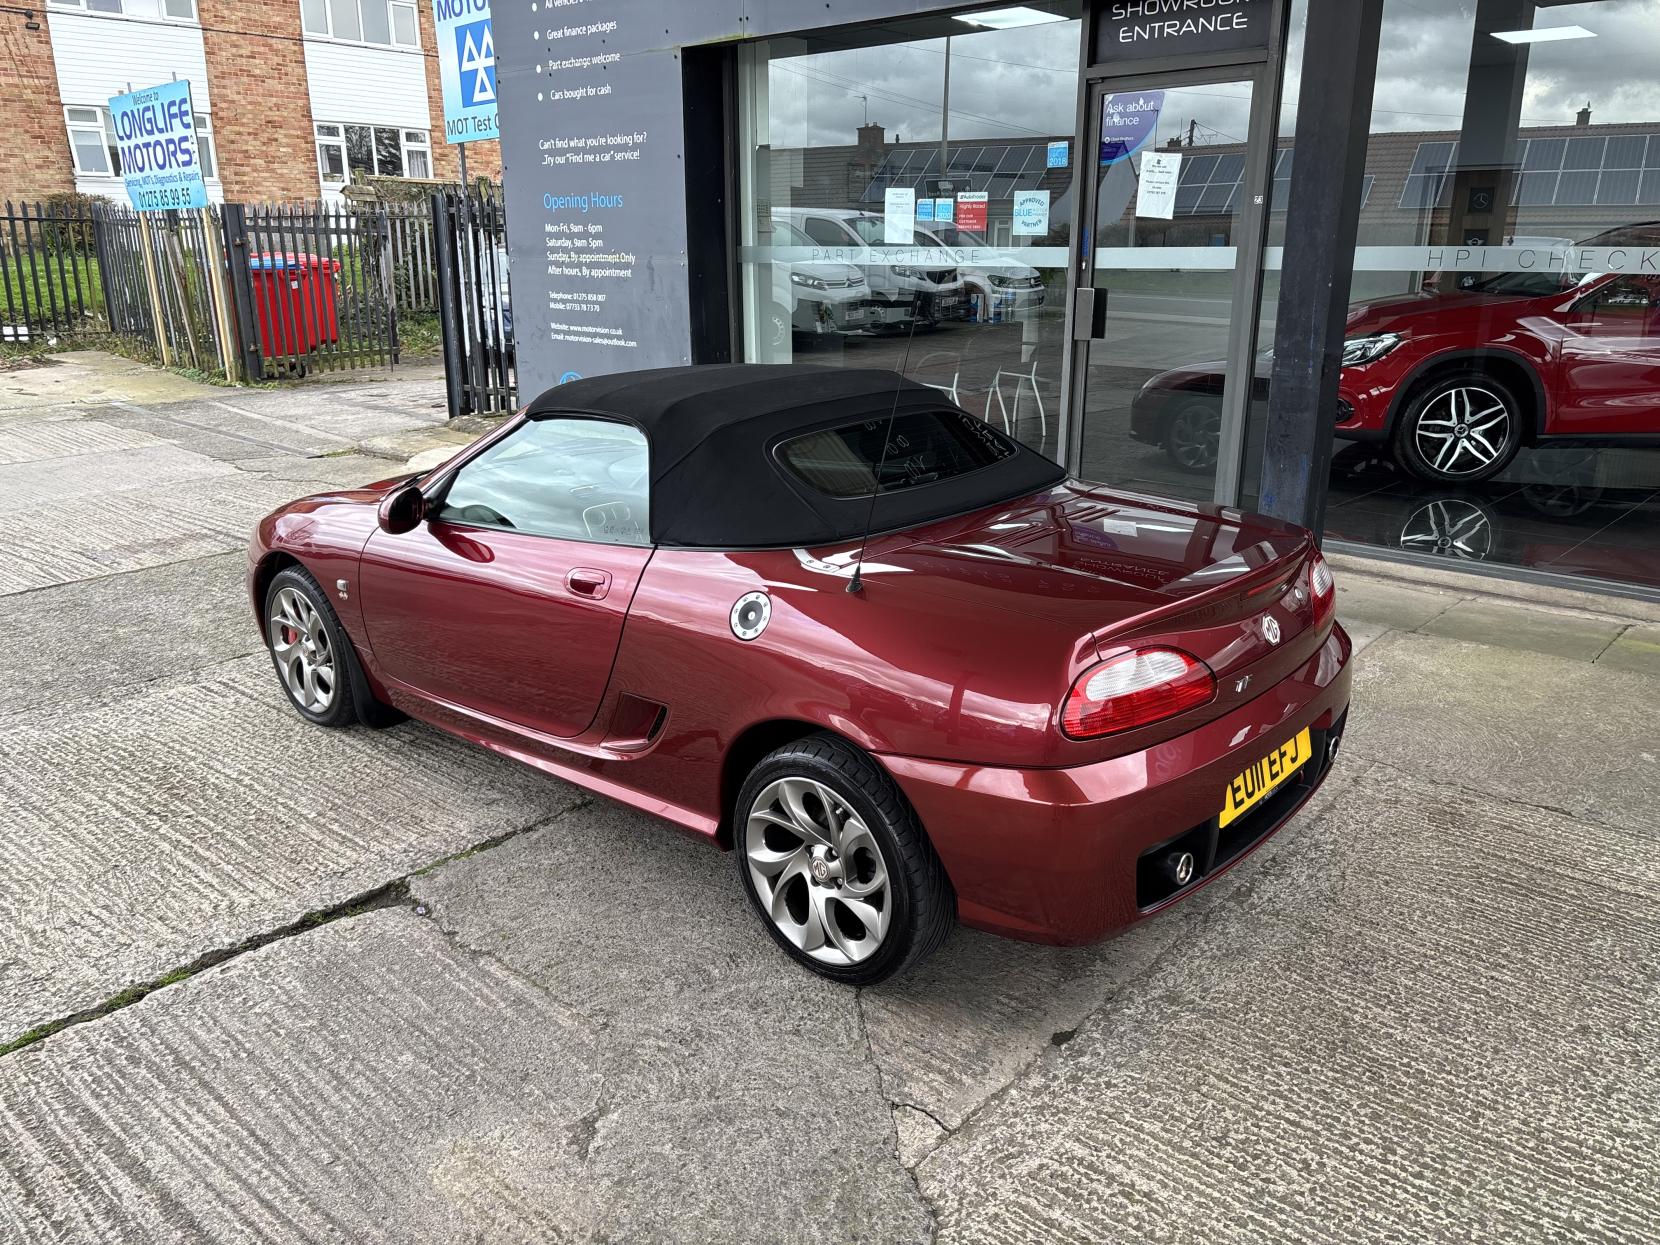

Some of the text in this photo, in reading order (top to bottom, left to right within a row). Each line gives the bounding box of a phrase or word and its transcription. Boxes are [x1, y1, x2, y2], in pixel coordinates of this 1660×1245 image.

[436, 0, 489, 22] MOTO
[546, 20, 617, 40] Great finance packages
[1119, 12, 1248, 43] ENTRANCE
[548, 53, 620, 70] Part exchange welcome
[131, 92, 159, 106] Welcome to
[550, 83, 612, 100] Cars bought for cash
[1106, 100, 1155, 114] Ask about
[112, 97, 192, 141] LONGLIFE
[446, 117, 470, 137] MOT
[471, 115, 492, 133] Test
[1105, 115, 1140, 127] finance
[538, 132, 647, 150] Can't find what you're looking for?
[120, 135, 193, 175] MOTORS
[554, 156, 566, 164] our
[584, 154, 595, 162] me
[595, 154, 600, 162] a
[614, 149, 640, 161] service!
[154, 173, 178, 187] Diagnostics
[183, 171, 200, 184] Repairs
[138, 187, 191, 208] 01275 85 99 55
[543, 191, 624, 213] Opening Hours
[1019, 197, 1045, 207] APPROVED
[1014, 208, 1032, 217] BLUE
[545, 223, 569, 234] Mon-Fri,
[570, 223, 583, 233] 9am
[588, 223, 602, 235] 6pm
[1021, 218, 1042, 228] PARTNER
[546, 236, 603, 250] Saturday, 9am 5pm
[546, 249, 636, 265] Sunday, By appointment Only
[812, 249, 980, 264] PART EXCHANGE
[1427, 249, 1660, 270] HPI CHECK
[547, 264, 632, 279] After hours, By appointment
[573, 292, 587, 301] 01275
[1262, 616, 1281, 644] MG
[1231, 734, 1299, 810] EU11 EFJ
[813, 860, 828, 878] MG
